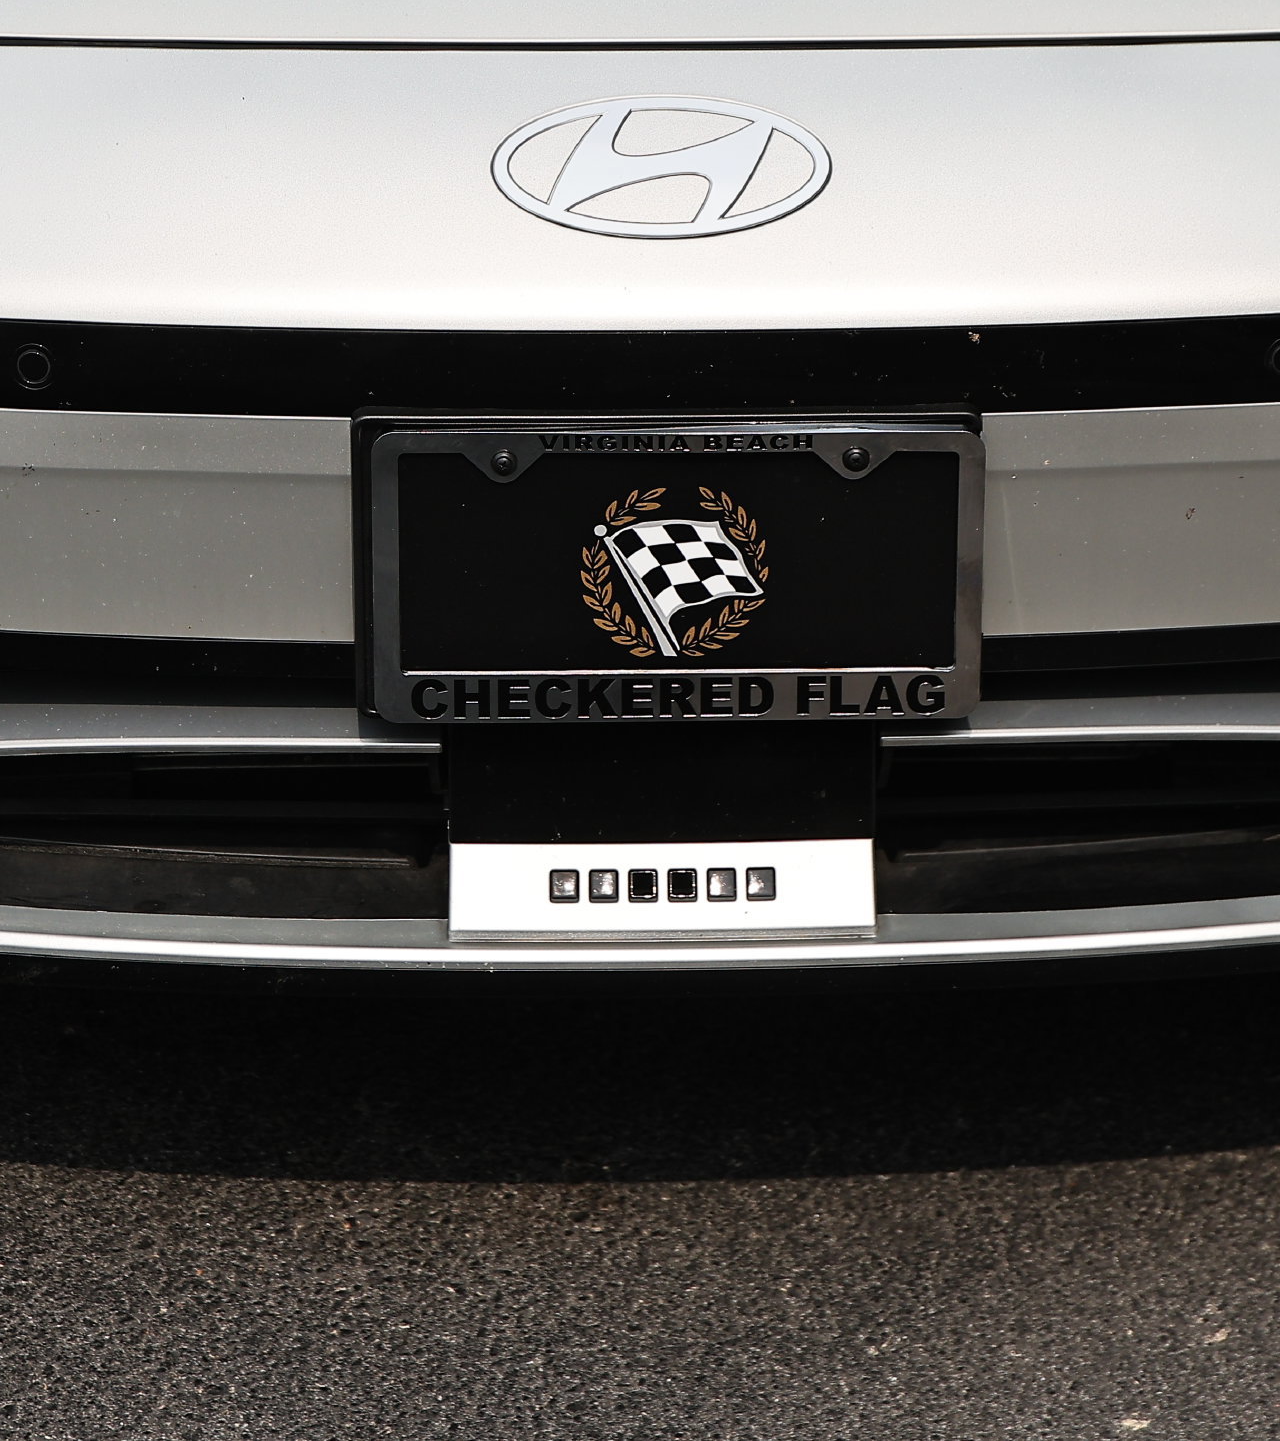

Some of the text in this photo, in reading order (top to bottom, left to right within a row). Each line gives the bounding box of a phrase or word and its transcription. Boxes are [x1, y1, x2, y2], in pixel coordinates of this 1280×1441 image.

[538, 434, 813, 452] VIRGINIA BEACH
[410, 675, 946, 720] CHECKERED FLAG
